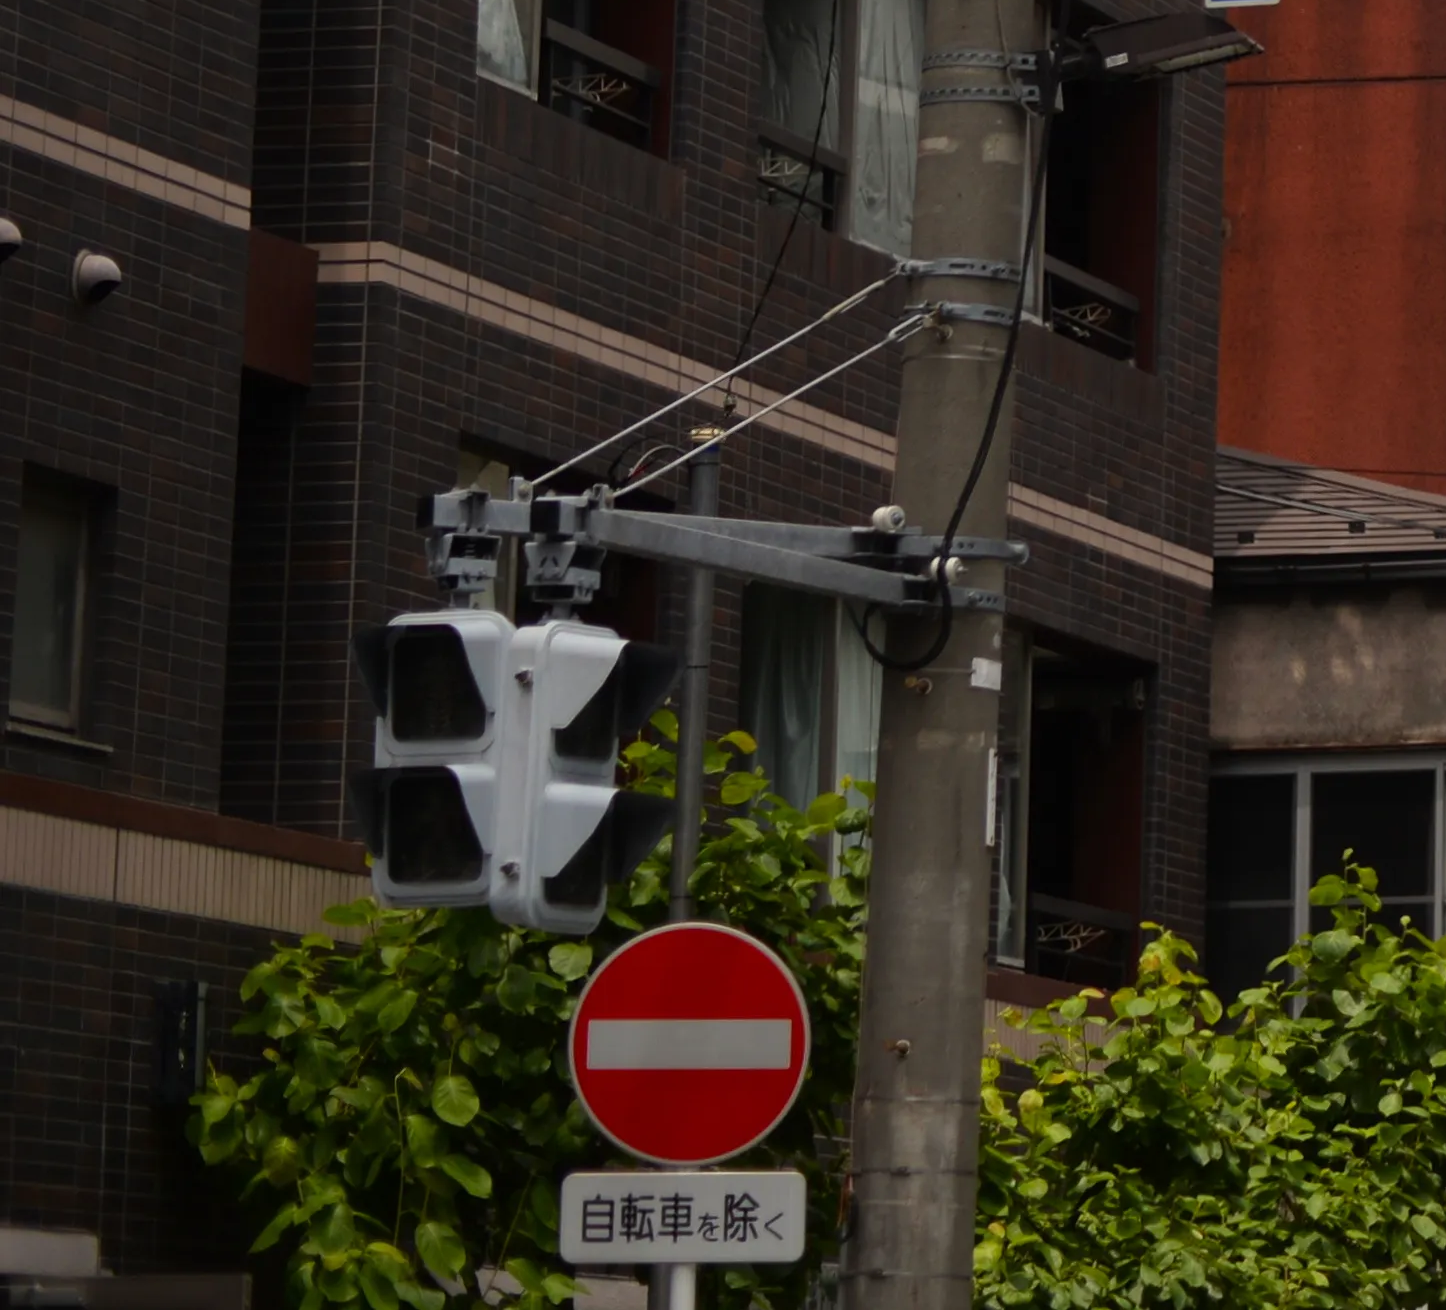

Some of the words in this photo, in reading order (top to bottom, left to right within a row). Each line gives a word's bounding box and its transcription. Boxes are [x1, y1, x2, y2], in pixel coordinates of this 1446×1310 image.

[581, 1192, 785, 1244] 自転車を除く
